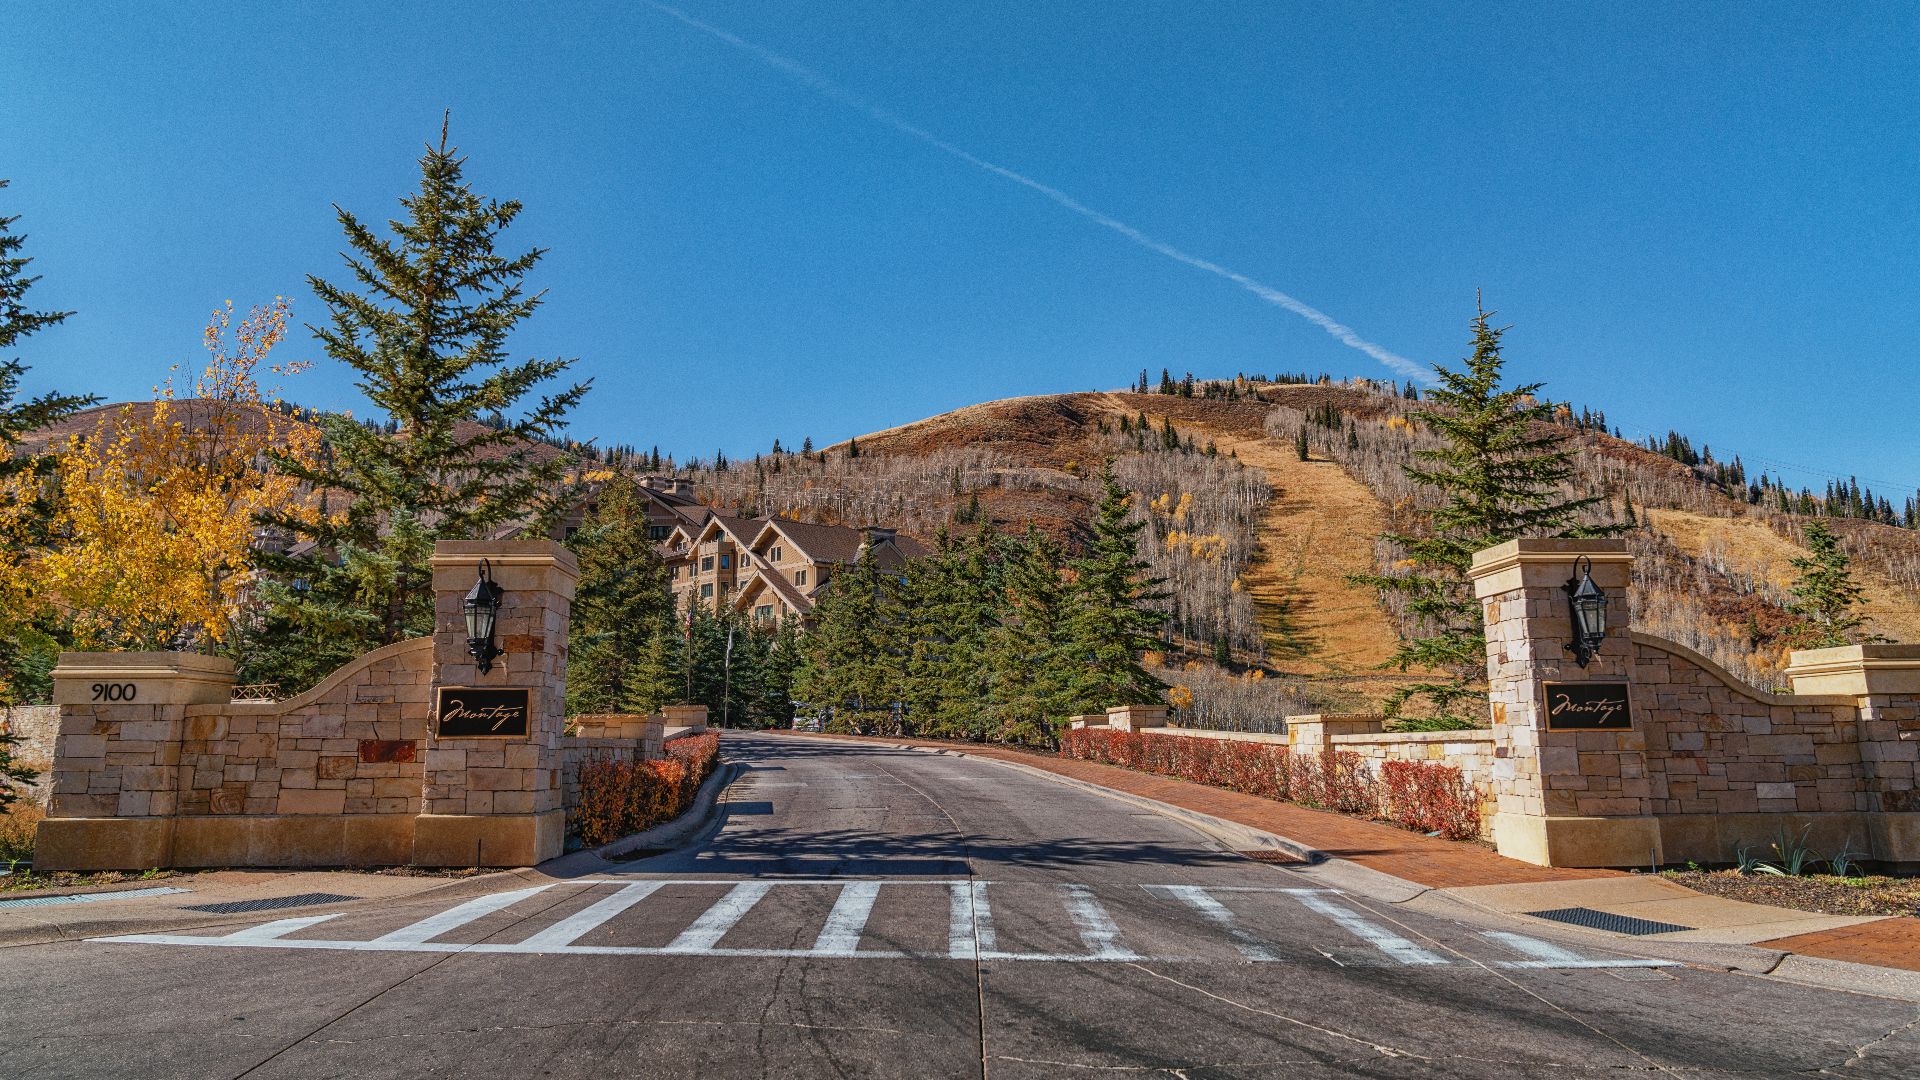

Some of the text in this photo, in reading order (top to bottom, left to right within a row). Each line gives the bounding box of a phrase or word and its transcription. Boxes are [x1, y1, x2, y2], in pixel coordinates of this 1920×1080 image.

[92, 683, 136, 701] 9100
[443, 700, 523, 731] Montage
[1552, 694, 1625, 724] Montage
